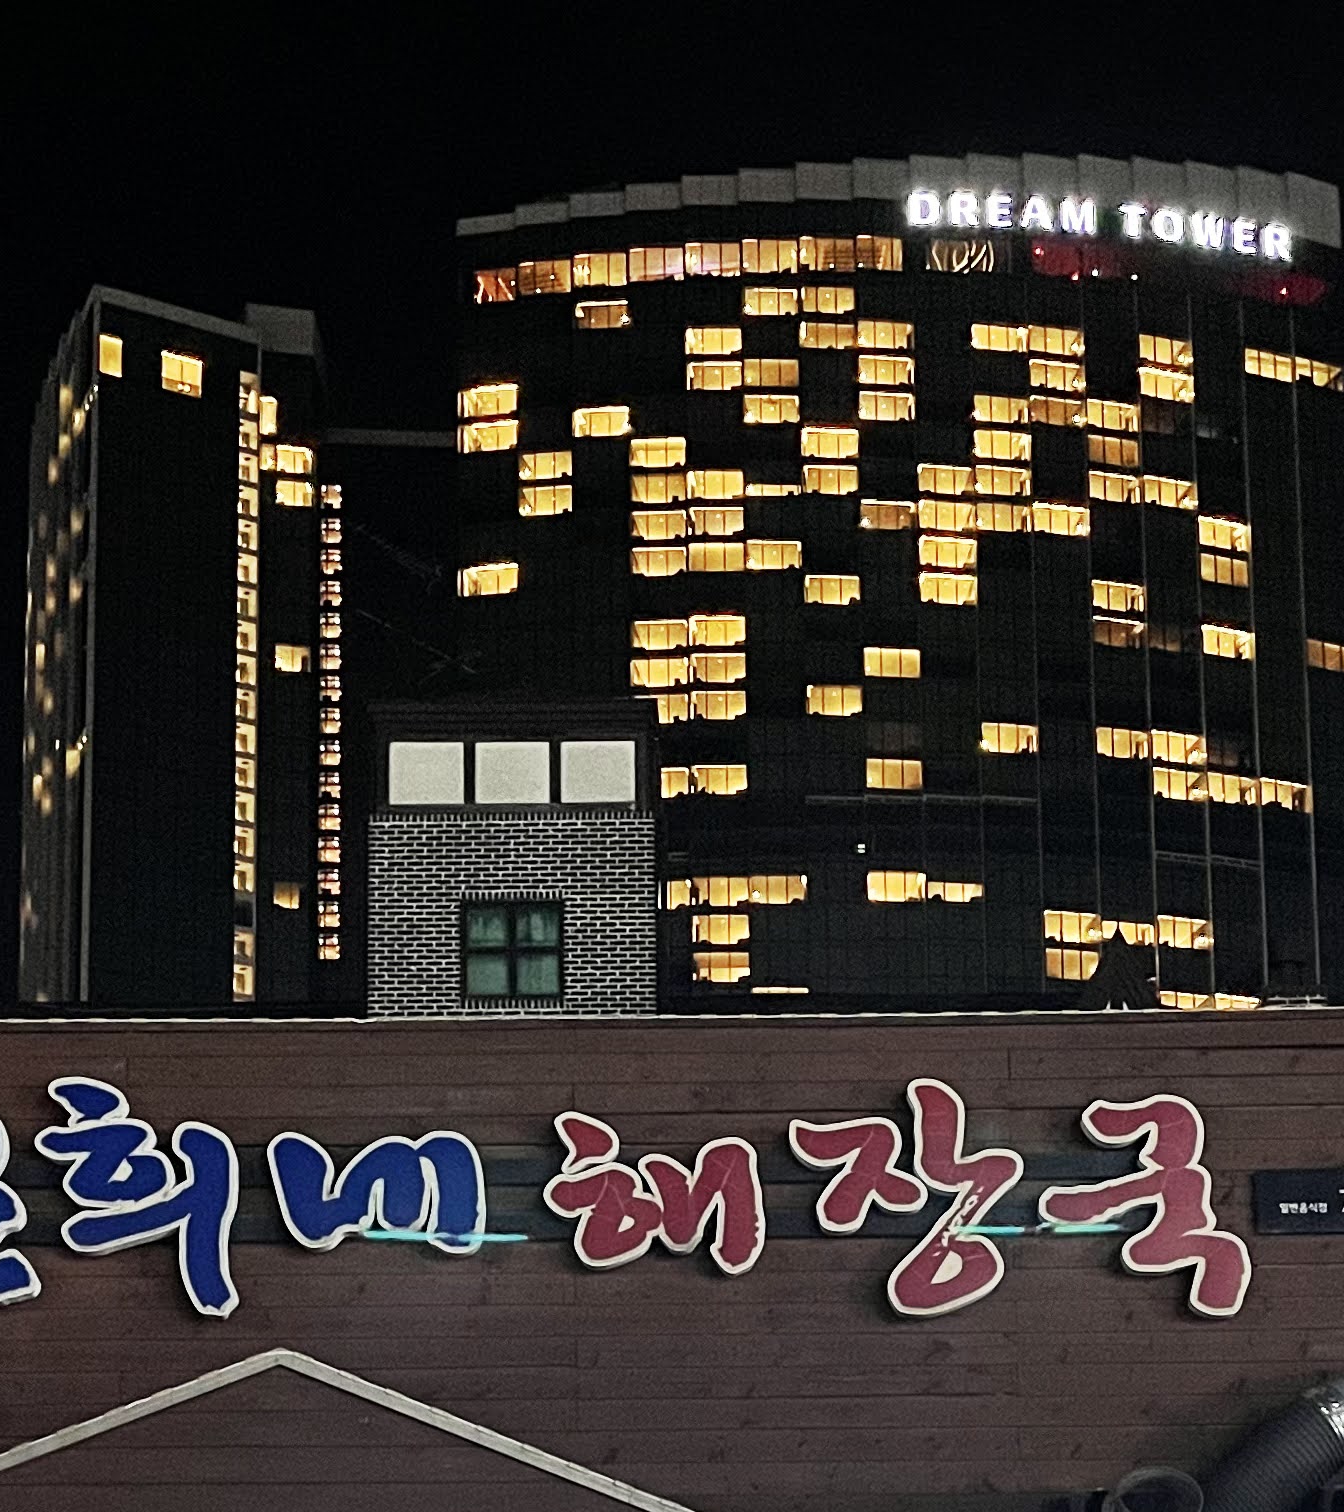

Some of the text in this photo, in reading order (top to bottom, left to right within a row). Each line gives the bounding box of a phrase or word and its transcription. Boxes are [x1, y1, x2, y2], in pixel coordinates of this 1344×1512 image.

[906, 189, 1294, 262] DREAM TOWER
[544, 1077, 1252, 1318] 해장국
